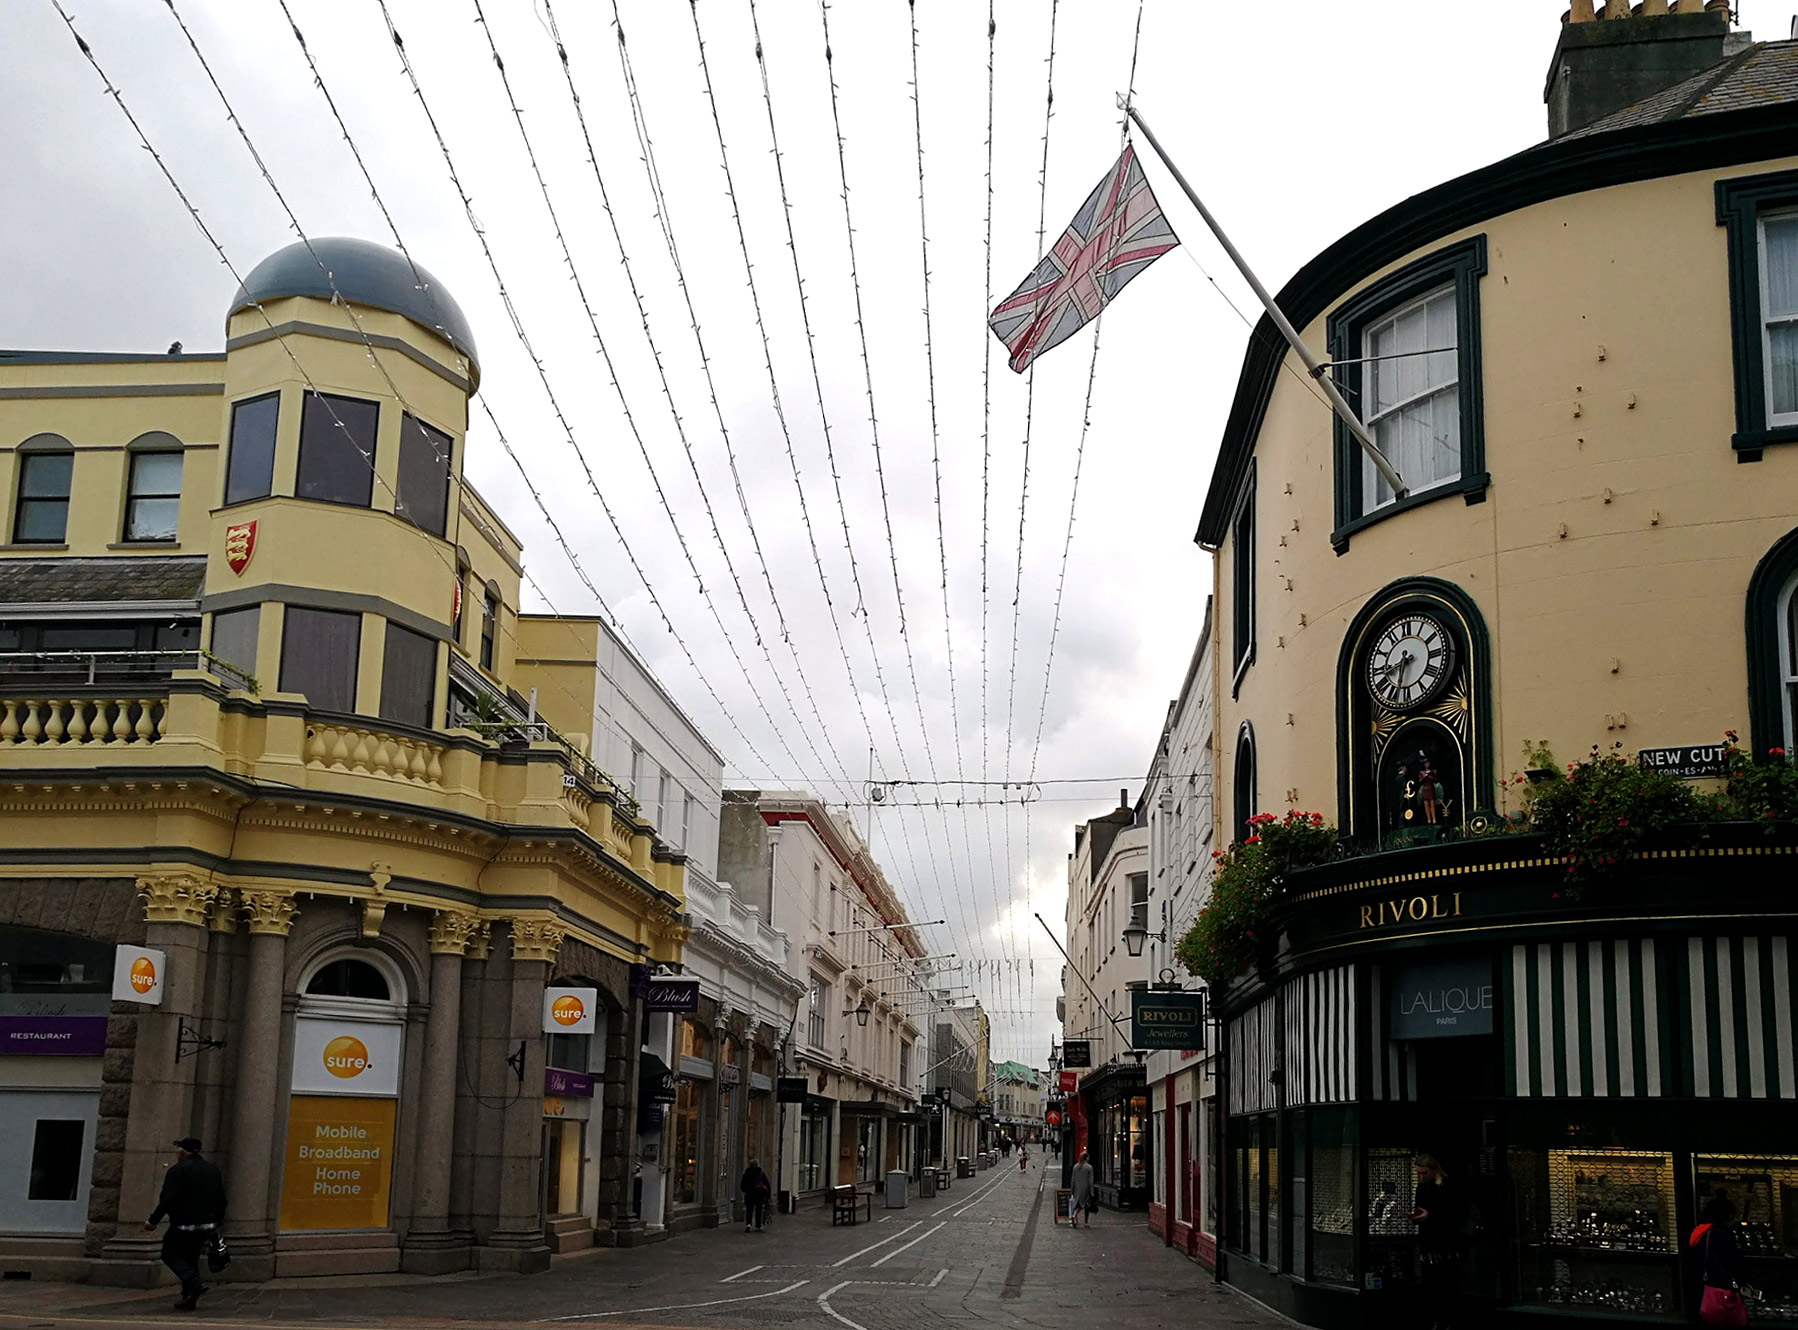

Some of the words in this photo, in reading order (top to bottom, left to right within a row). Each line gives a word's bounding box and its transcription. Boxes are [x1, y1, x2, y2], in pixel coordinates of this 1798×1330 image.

[1642, 750, 1682, 767] NEW
[1690, 748, 1726, 764] CUT
[1360, 892, 1464, 929] RIVOLI
[647, 986, 693, 1003] Blush
[1400, 985, 1493, 1015] LALIQUE
[1143, 1010, 1192, 1022] RIVOLI
[1436, 1017, 1457, 1026] PARIS
[10, 1032, 72, 1040] RESTAURANT
[1146, 1028, 1189, 1038] Jewellers
[316, 1125, 367, 1139] Mobile
[299, 1145, 380, 1160] Broadband
[316, 1167, 361, 1180] Home
[313, 1182, 361, 1195] Phone
